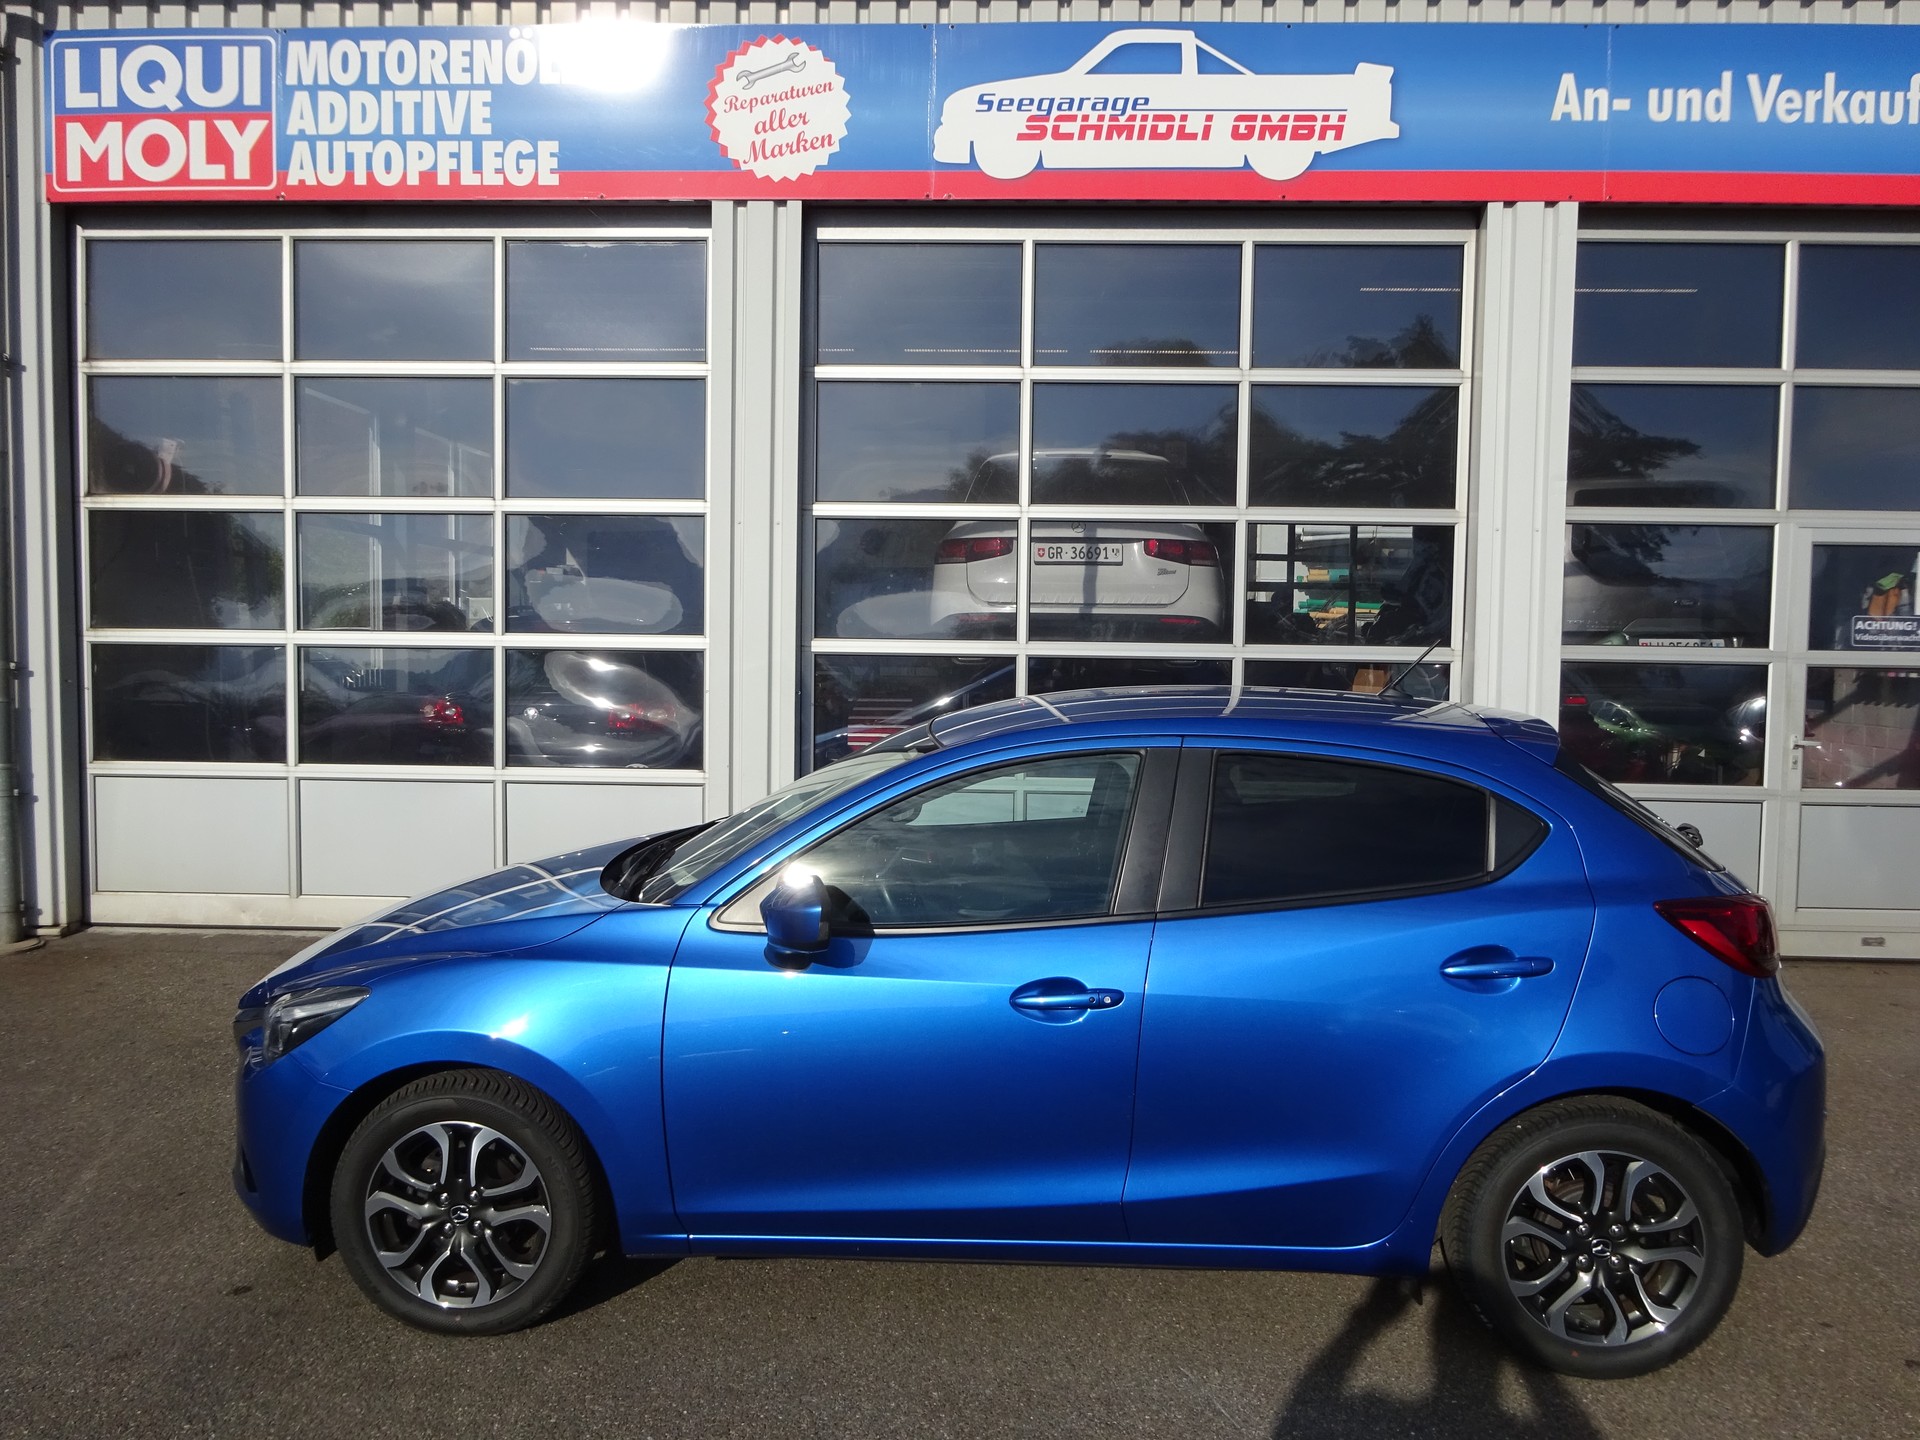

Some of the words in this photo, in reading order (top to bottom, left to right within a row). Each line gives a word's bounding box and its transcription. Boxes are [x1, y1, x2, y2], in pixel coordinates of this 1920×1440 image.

[285, 27, 582, 86] MOTORENÖL
[64, 44, 262, 112] LIQUI
[723, 81, 834, 113] Reparaturen
[1551, 72, 1632, 122] An-
[1648, 70, 1734, 123] und
[1746, 71, 1920, 125] Verkauf
[286, 90, 492, 136] ADDITIVE
[754, 107, 810, 135] aller
[975, 93, 1150, 117] Seegarage
[742, 130, 836, 165] Marken
[1016, 114, 1214, 141] SCHMIDLI
[1230, 114, 1347, 141] GMBH
[65, 118, 270, 183] MOLY
[286, 139, 560, 187] AUTOPFLEGE
[1855, 620, 1918, 631] ACHTUNG!
